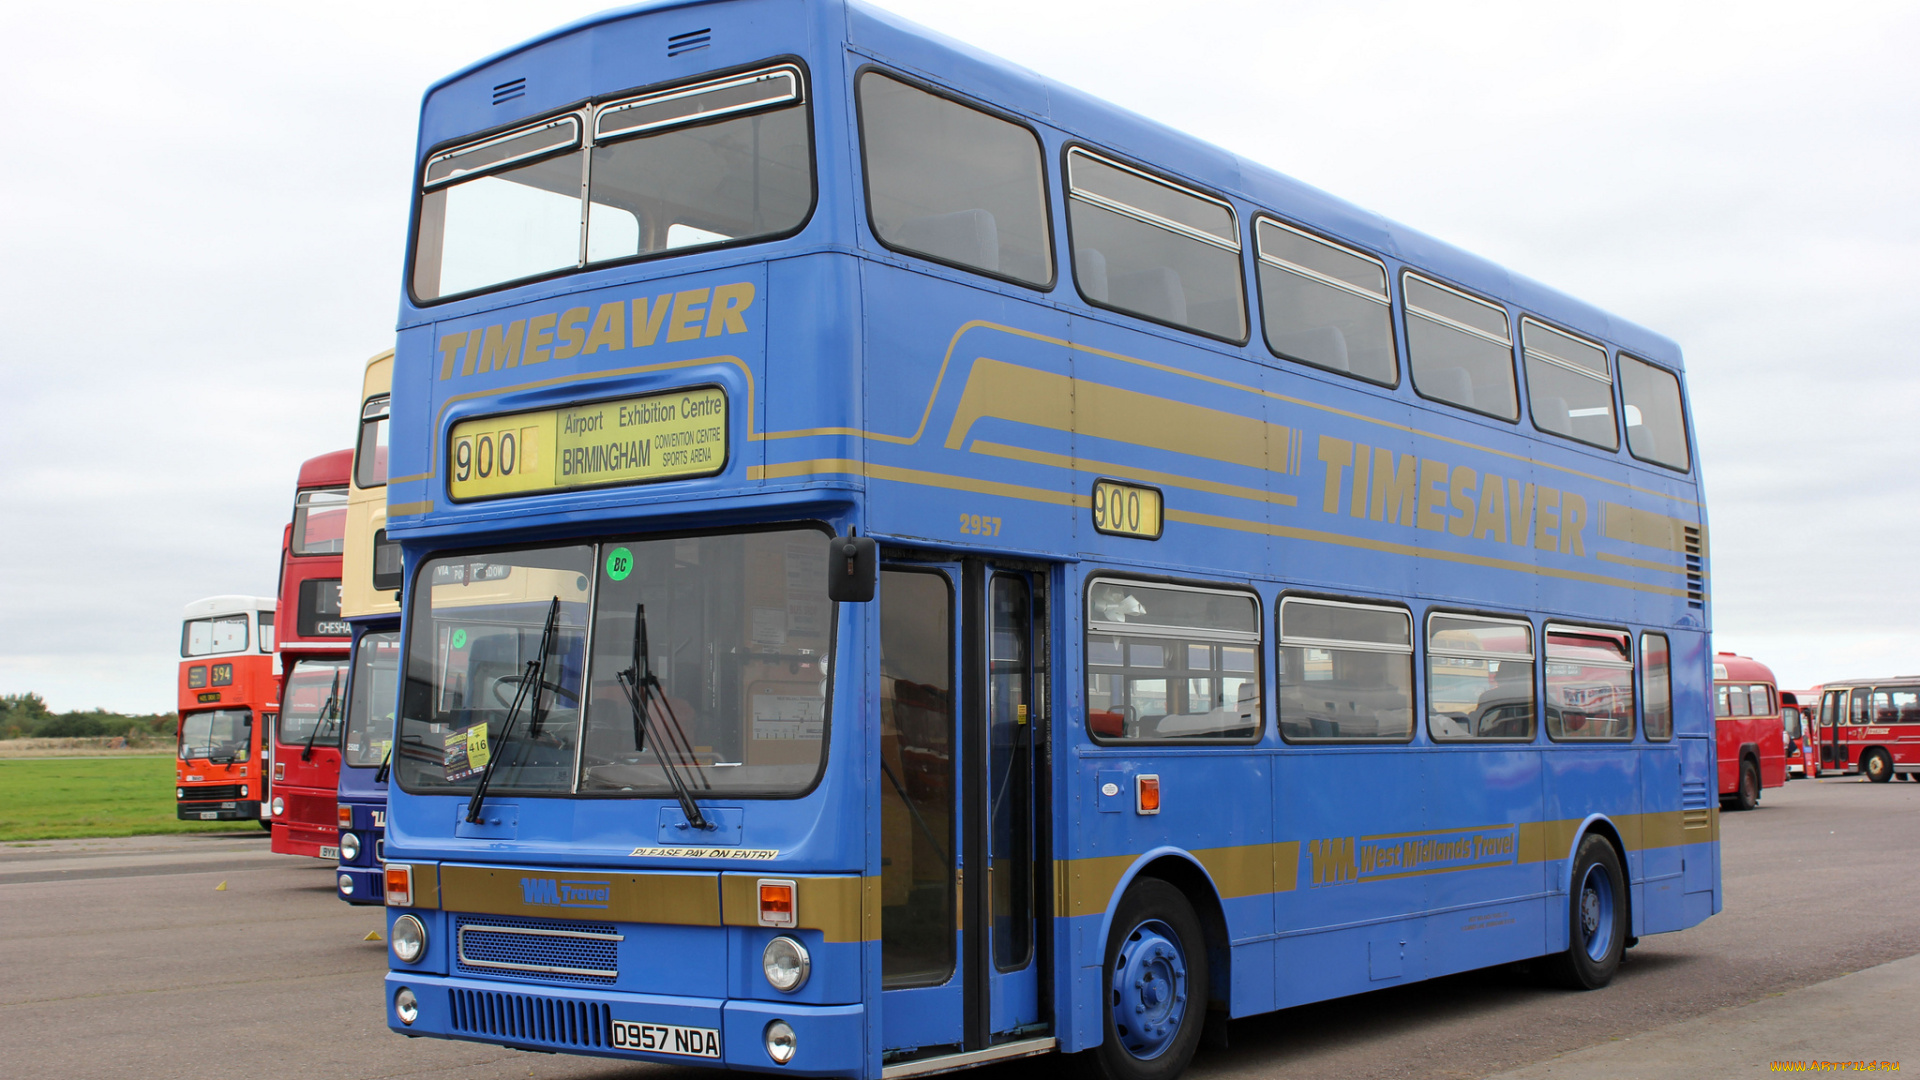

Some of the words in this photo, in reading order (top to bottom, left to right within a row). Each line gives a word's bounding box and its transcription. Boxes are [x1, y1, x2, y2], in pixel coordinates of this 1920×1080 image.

[438, 282, 755, 381] TIMESAVER
[564, 411, 603, 437] Airport
[619, 401, 676, 427] Exhibition
[681, 396, 722, 419] Centre
[655, 430, 694, 450] CONVENTION
[696, 427, 721, 444] CENTRE
[456, 432, 516, 482] 900
[563, 439, 651, 476] BIRMINGHAM
[663, 450, 688, 468] SPORTS
[690, 447, 711, 463] ARENA
[1317, 435, 1586, 557] TIMESAVER
[1095, 485, 1140, 532] 900
[959, 513, 1002, 537] 2957
[437, 564, 449, 576] VIA
[613, 556, 627, 573] BC
[213, 666, 231, 682] 394
[469, 739, 487, 752] 416
[633, 848, 682, 857] PLEASE
[683, 849, 708, 858] PAY
[709, 849, 732, 858] ON
[731, 850, 777, 860] ENTRY
[1360, 843, 1401, 873] West
[1402, 837, 1472, 868] Midlands
[1473, 833, 1515, 860] Travel
[560, 885, 610, 902] Travel
[614, 1023, 669, 1050] D957
[675, 1028, 718, 1056] NDA
